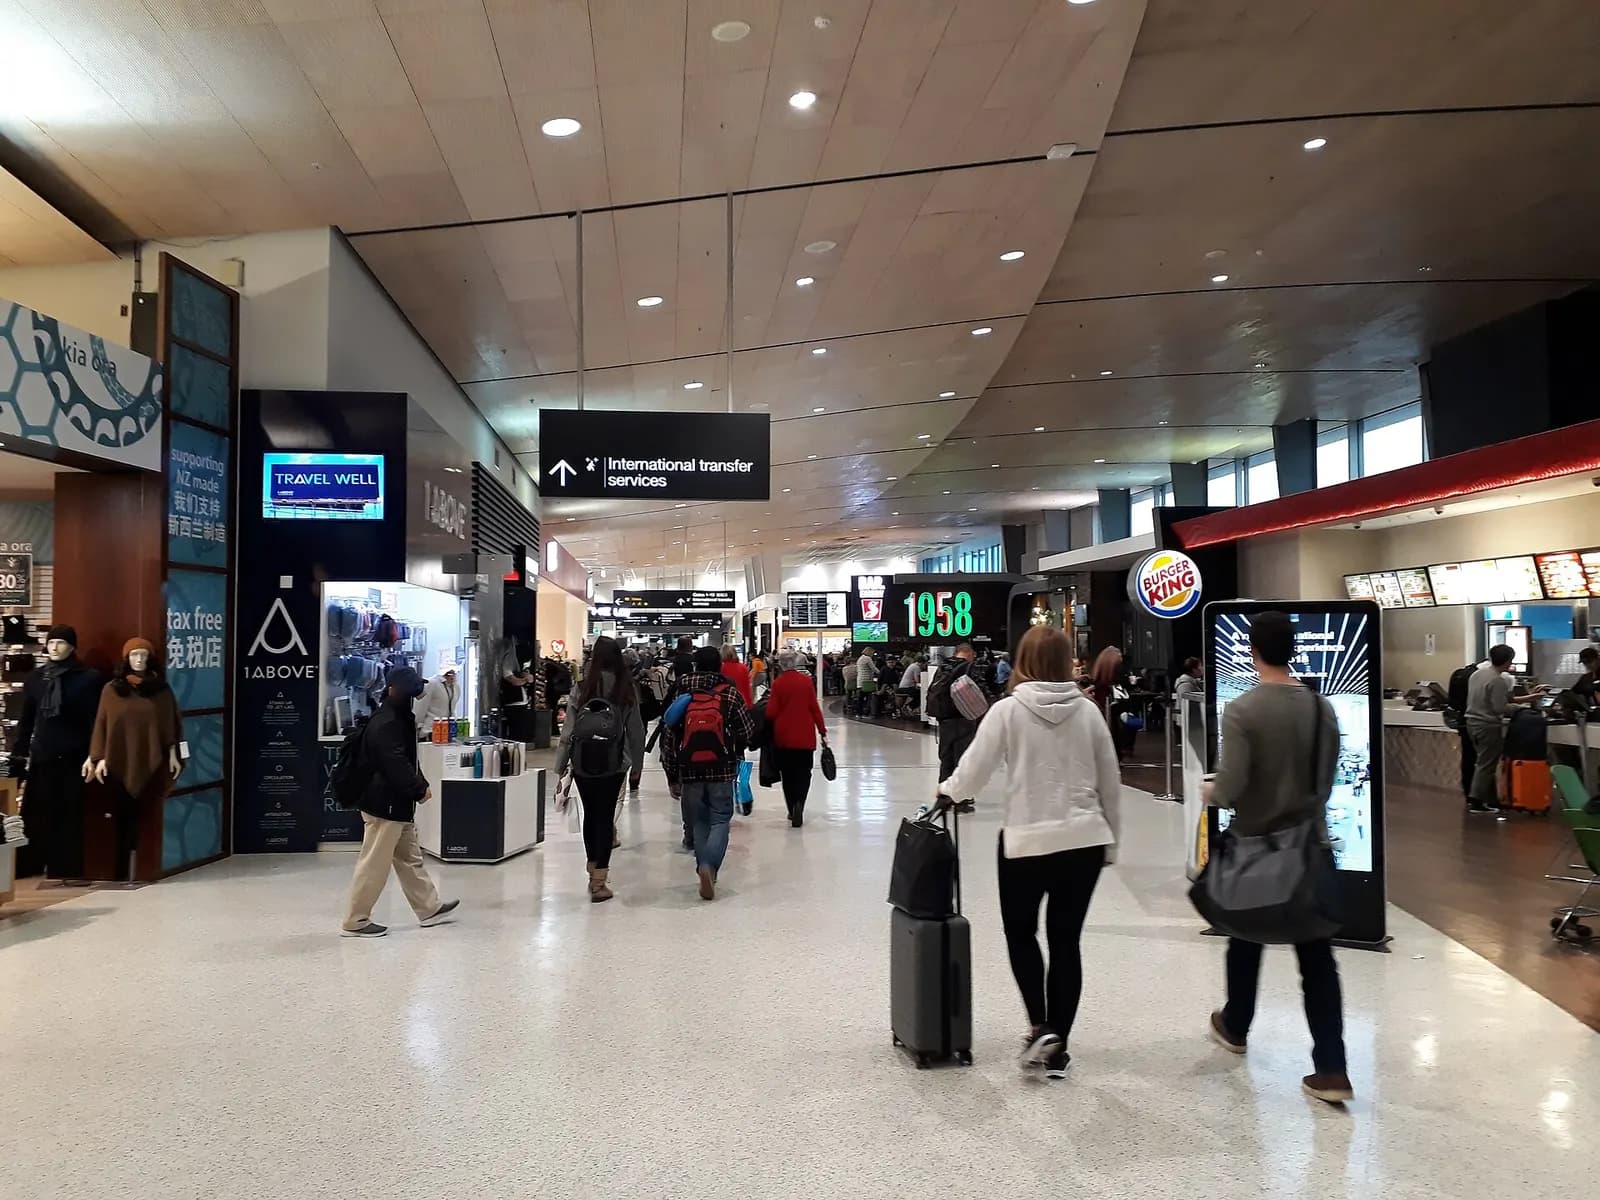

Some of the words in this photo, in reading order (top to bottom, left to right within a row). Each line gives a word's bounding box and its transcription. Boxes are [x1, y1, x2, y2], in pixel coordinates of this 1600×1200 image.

[63, 335, 86, 367] kia
[92, 356, 117, 378] ora
[170, 450, 225, 476] supporting
[608, 457, 695, 472] International
[699, 457, 753, 473] transfer
[176, 469, 191, 487] NZ
[193, 472, 219, 494] made
[275, 473, 331, 485] TRAVEL
[335, 473, 376, 485] WELL
[608, 474, 667, 487] services
[174, 490, 221, 519] 我们支持
[168, 513, 226, 543] 新西兰制造
[1143, 559, 1190, 591] BURGER
[1148, 570, 1195, 607] KING
[167, 607, 192, 630] tax
[194, 605, 223, 631] free
[904, 591, 973, 637] 1958
[167, 635, 222, 669] 免税店
[244, 665, 315, 679] 1ABOVE
